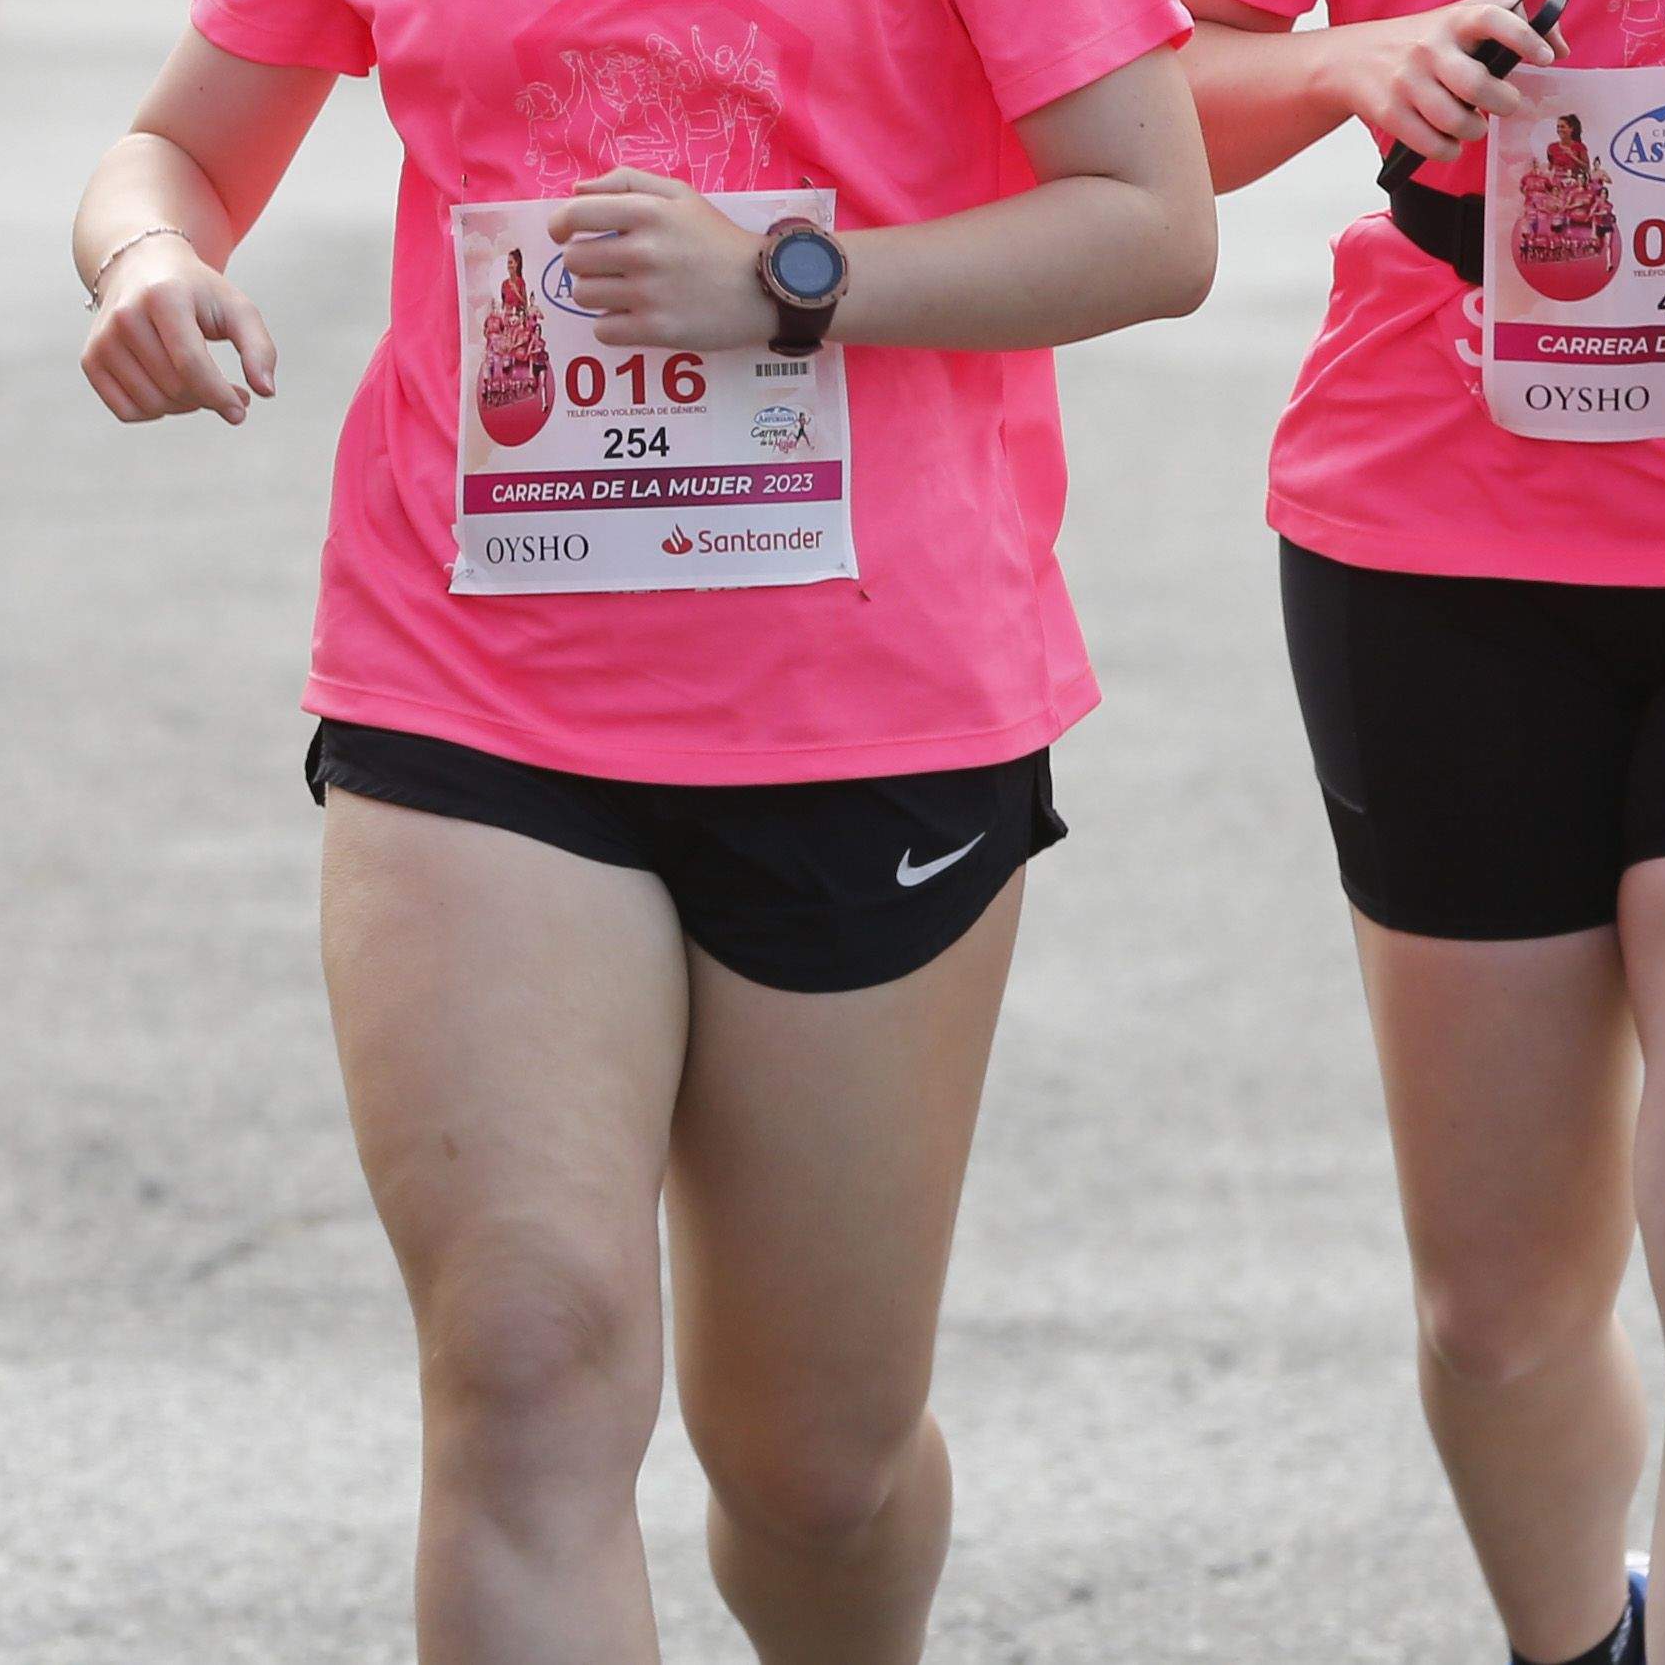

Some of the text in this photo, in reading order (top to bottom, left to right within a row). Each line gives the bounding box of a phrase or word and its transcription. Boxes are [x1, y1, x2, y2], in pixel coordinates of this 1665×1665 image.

[1537, 335, 1648, 355] CARRERA
[565, 352, 707, 407] 016
[566, 404, 707, 418] TELÉFONO VIOLENCIA DE GÉNERO
[1525, 384, 1650, 412] OYSHO
[604, 426, 670, 459] 254
[492, 473, 814, 503] CARRERA DE LA MUJER 2023
[486, 534, 589, 564] OYSHO
[698, 527, 823, 553] Santander
